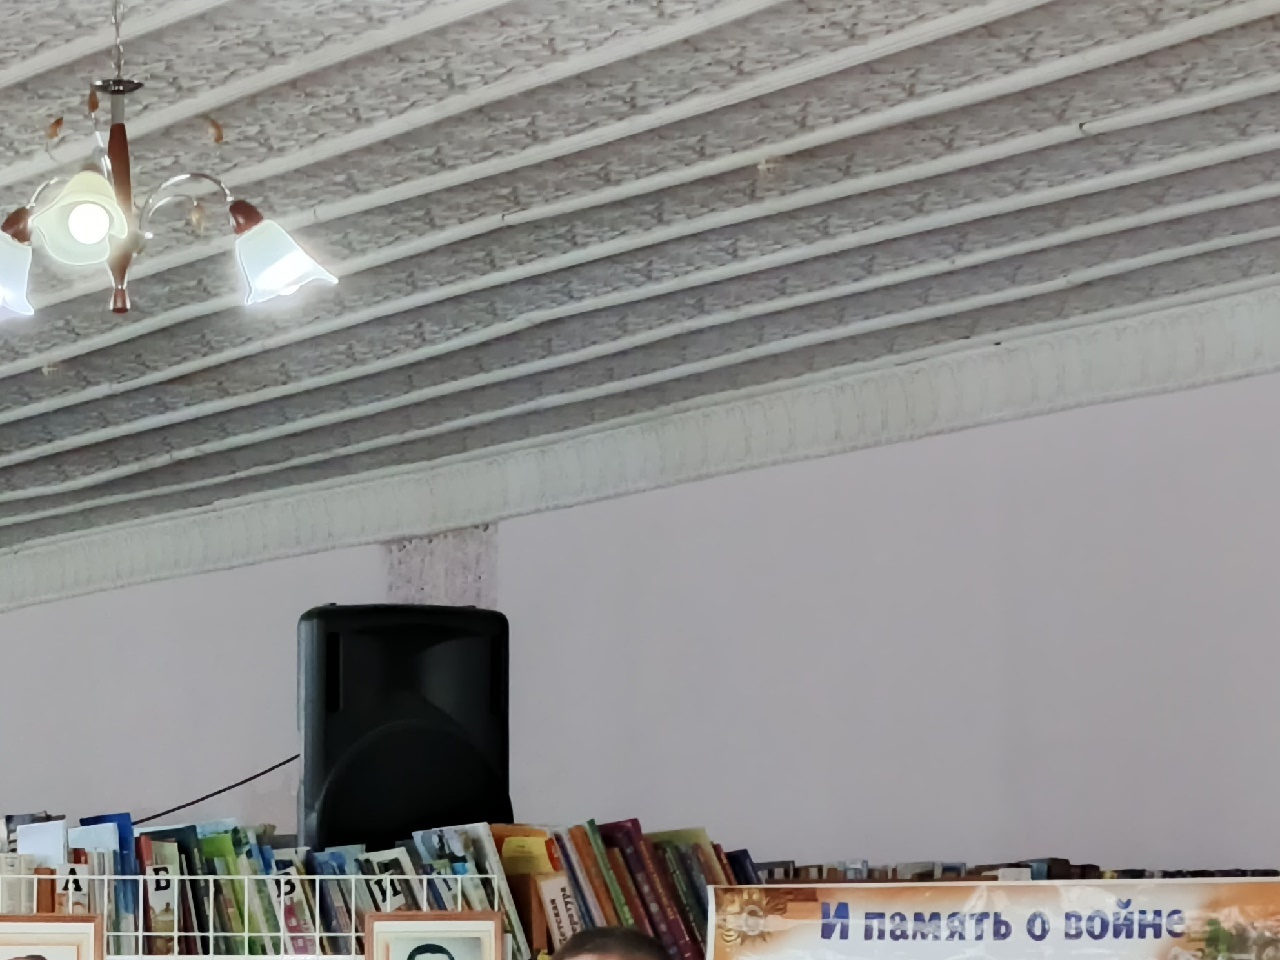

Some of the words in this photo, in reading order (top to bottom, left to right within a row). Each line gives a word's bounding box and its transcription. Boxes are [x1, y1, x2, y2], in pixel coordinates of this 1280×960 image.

[820, 902, 849, 940] И
[864, 912, 1012, 941] память
[1026, 910, 1051, 941] о
[1064, 898, 1187, 940] войне
